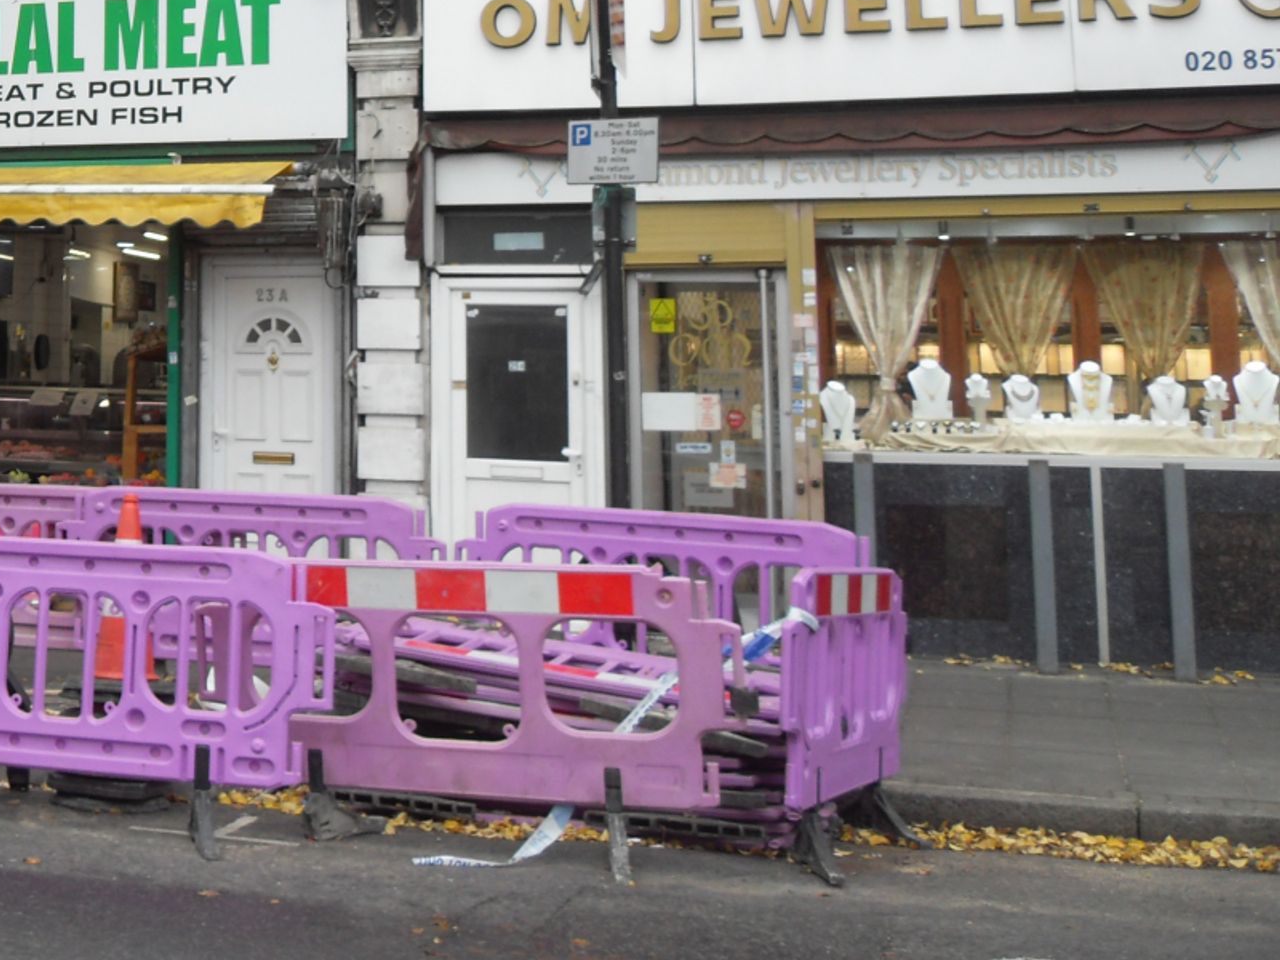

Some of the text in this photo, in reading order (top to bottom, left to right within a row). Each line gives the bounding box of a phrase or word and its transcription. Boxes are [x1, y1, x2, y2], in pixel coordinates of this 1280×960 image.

[1185, 51, 1233, 71] 020
[55, 82, 77, 100] &
[88, 76, 237, 98] POULTRY
[111, 106, 183, 125] FISH
[575, 126, 589, 145] P
[658, 150, 1118, 188] amond Jewellery Specialists
